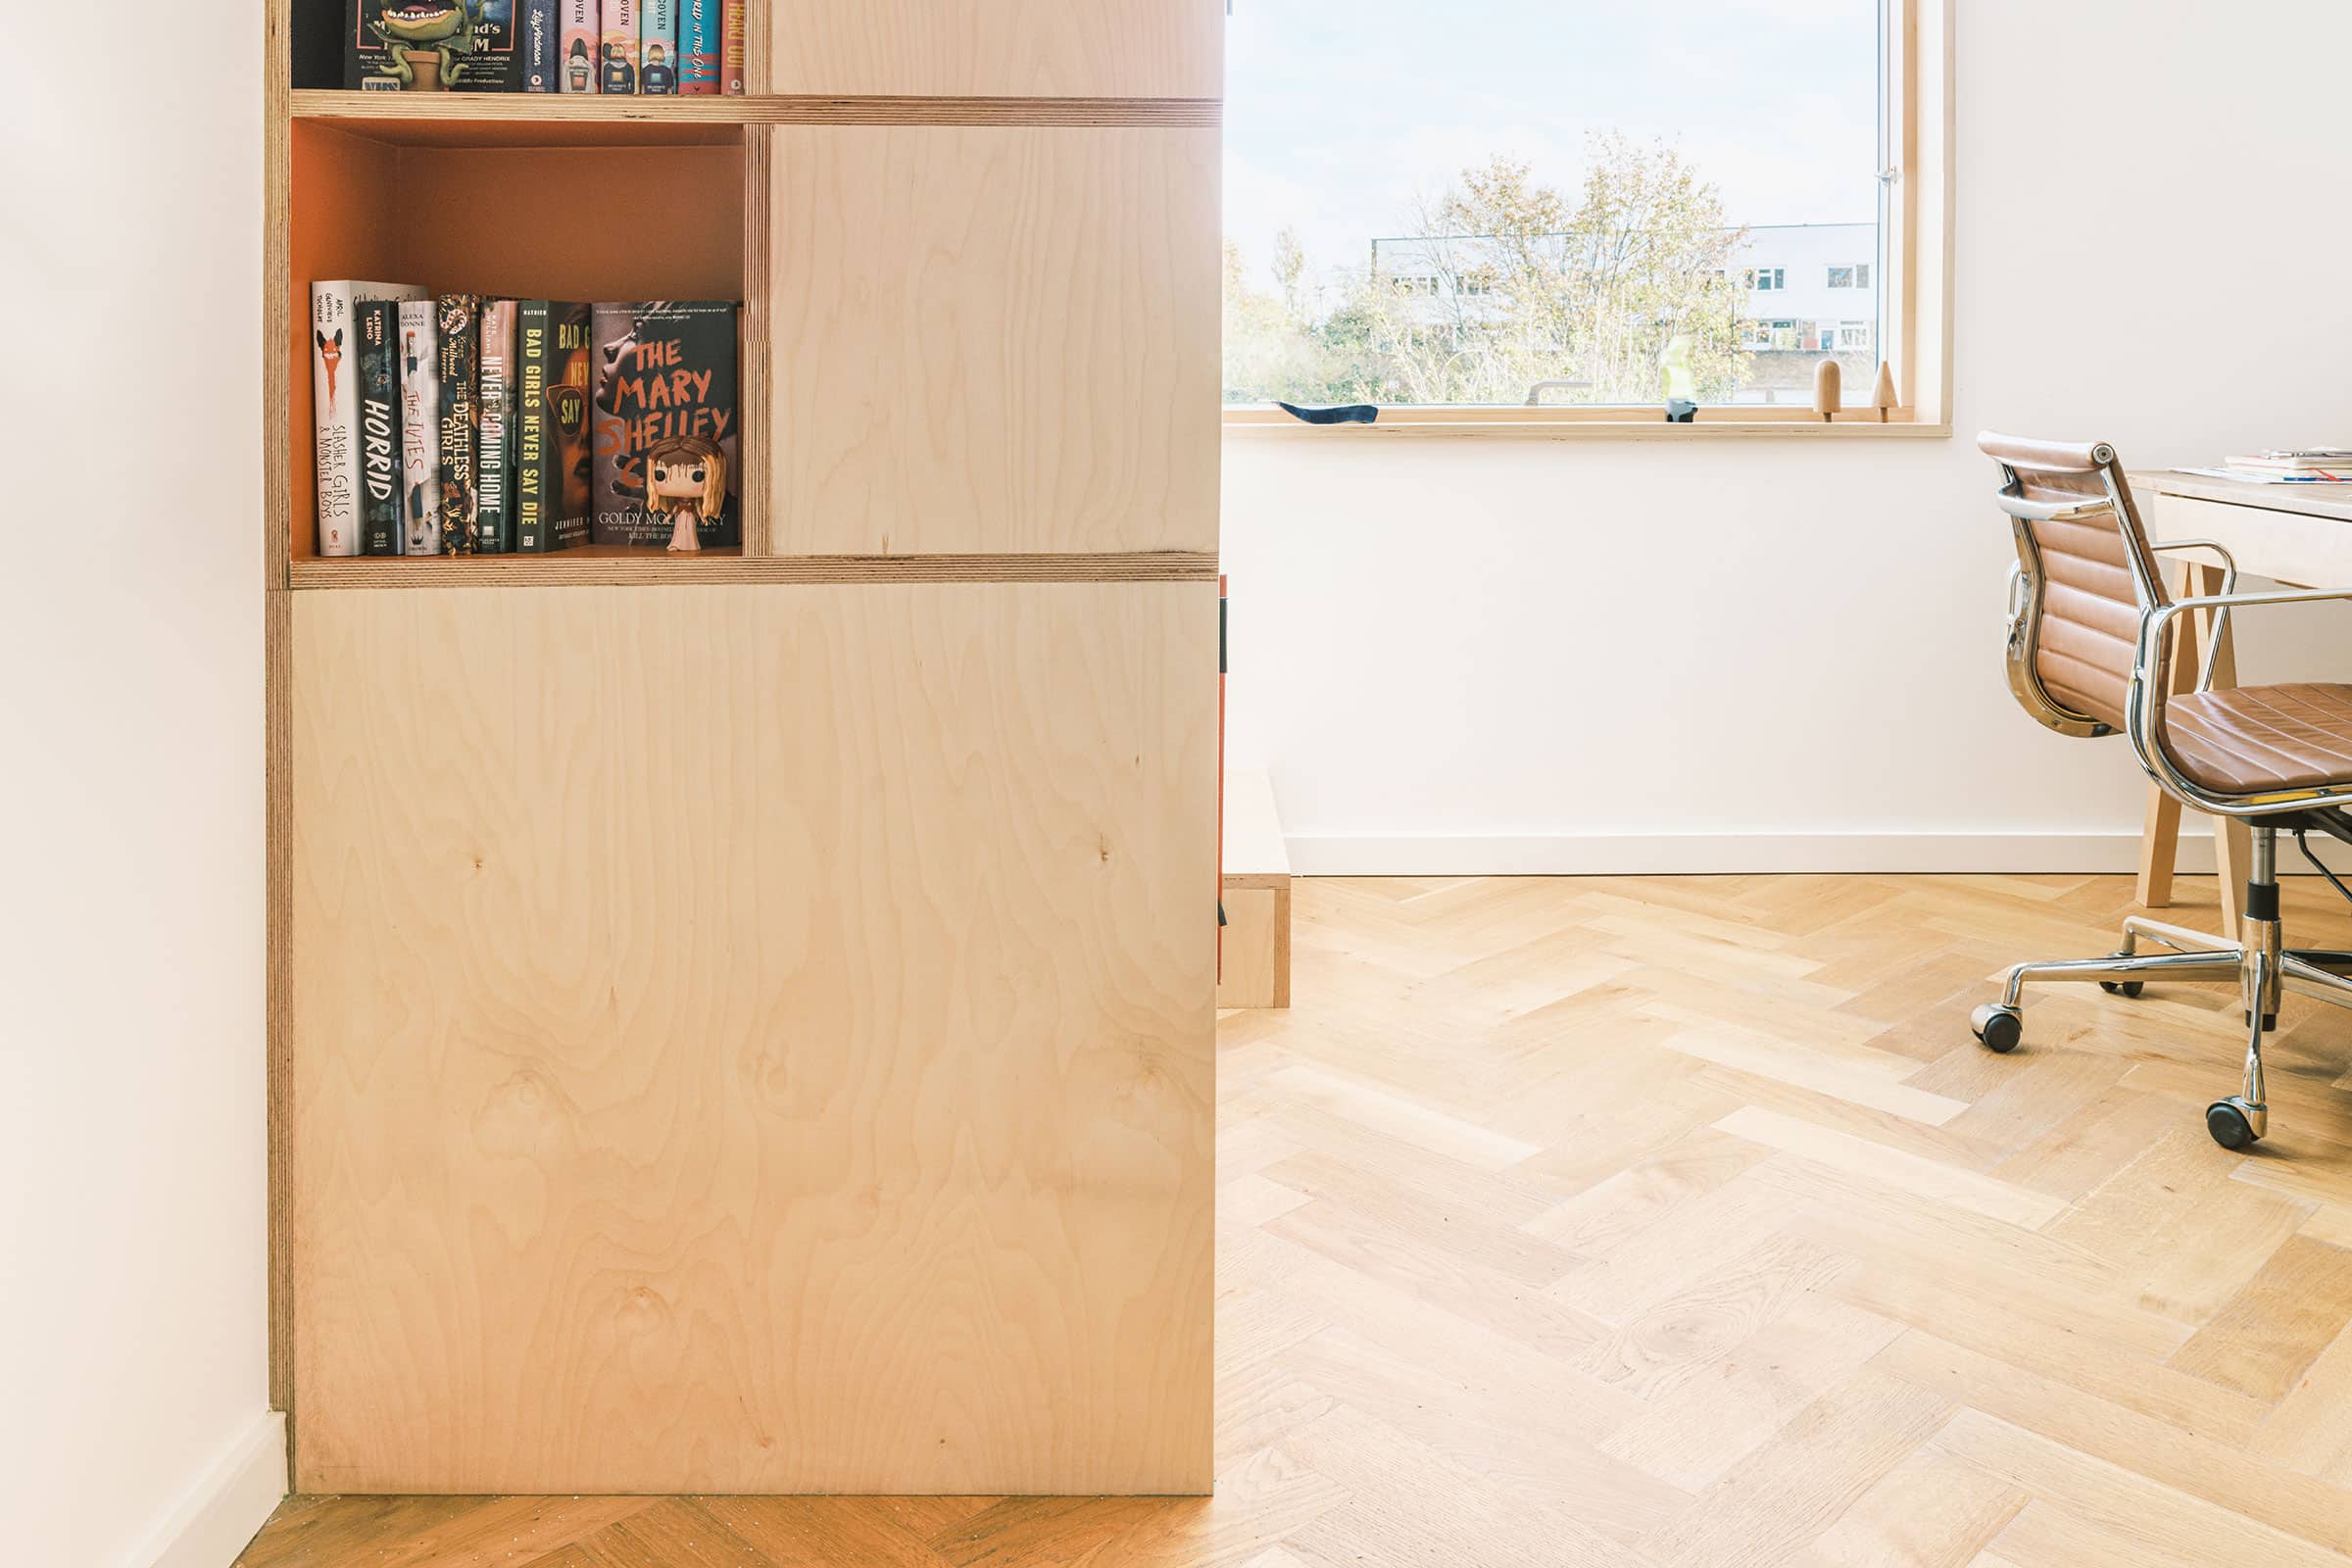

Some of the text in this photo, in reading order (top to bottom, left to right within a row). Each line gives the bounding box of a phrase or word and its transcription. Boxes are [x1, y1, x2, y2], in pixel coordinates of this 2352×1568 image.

[532, 25, 543, 66] Anderson
[366, 317, 374, 341] LENO
[373, 310, 382, 346] KATRINA
[525, 328, 543, 358] BAD
[559, 323, 580, 350] BAD
[570, 362, 590, 387] NEV
[628, 338, 683, 371] THE
[481, 356, 503, 400] NEVER
[524, 366, 540, 409] GIRLS
[613, 368, 711, 414] MARY
[407, 391, 419, 416] THE
[561, 398, 580, 424] SAY
[364, 399, 392, 500] HORRID
[441, 417, 454, 466] GIRLS
[453, 380, 469, 480] THE DEATHLESS
[479, 413, 502, 470] COMING
[523, 415, 540, 462] NEVER
[594, 408, 731, 456] SHELLEY
[318, 425, 333, 519] & MONSTER BOYS
[332, 424, 350, 517] SLASHER GIRLS
[522, 468, 539, 495] SAY
[479, 474, 501, 514] HOME
[521, 502, 538, 525] DIE
[598, 512, 642, 526] GOLDY
